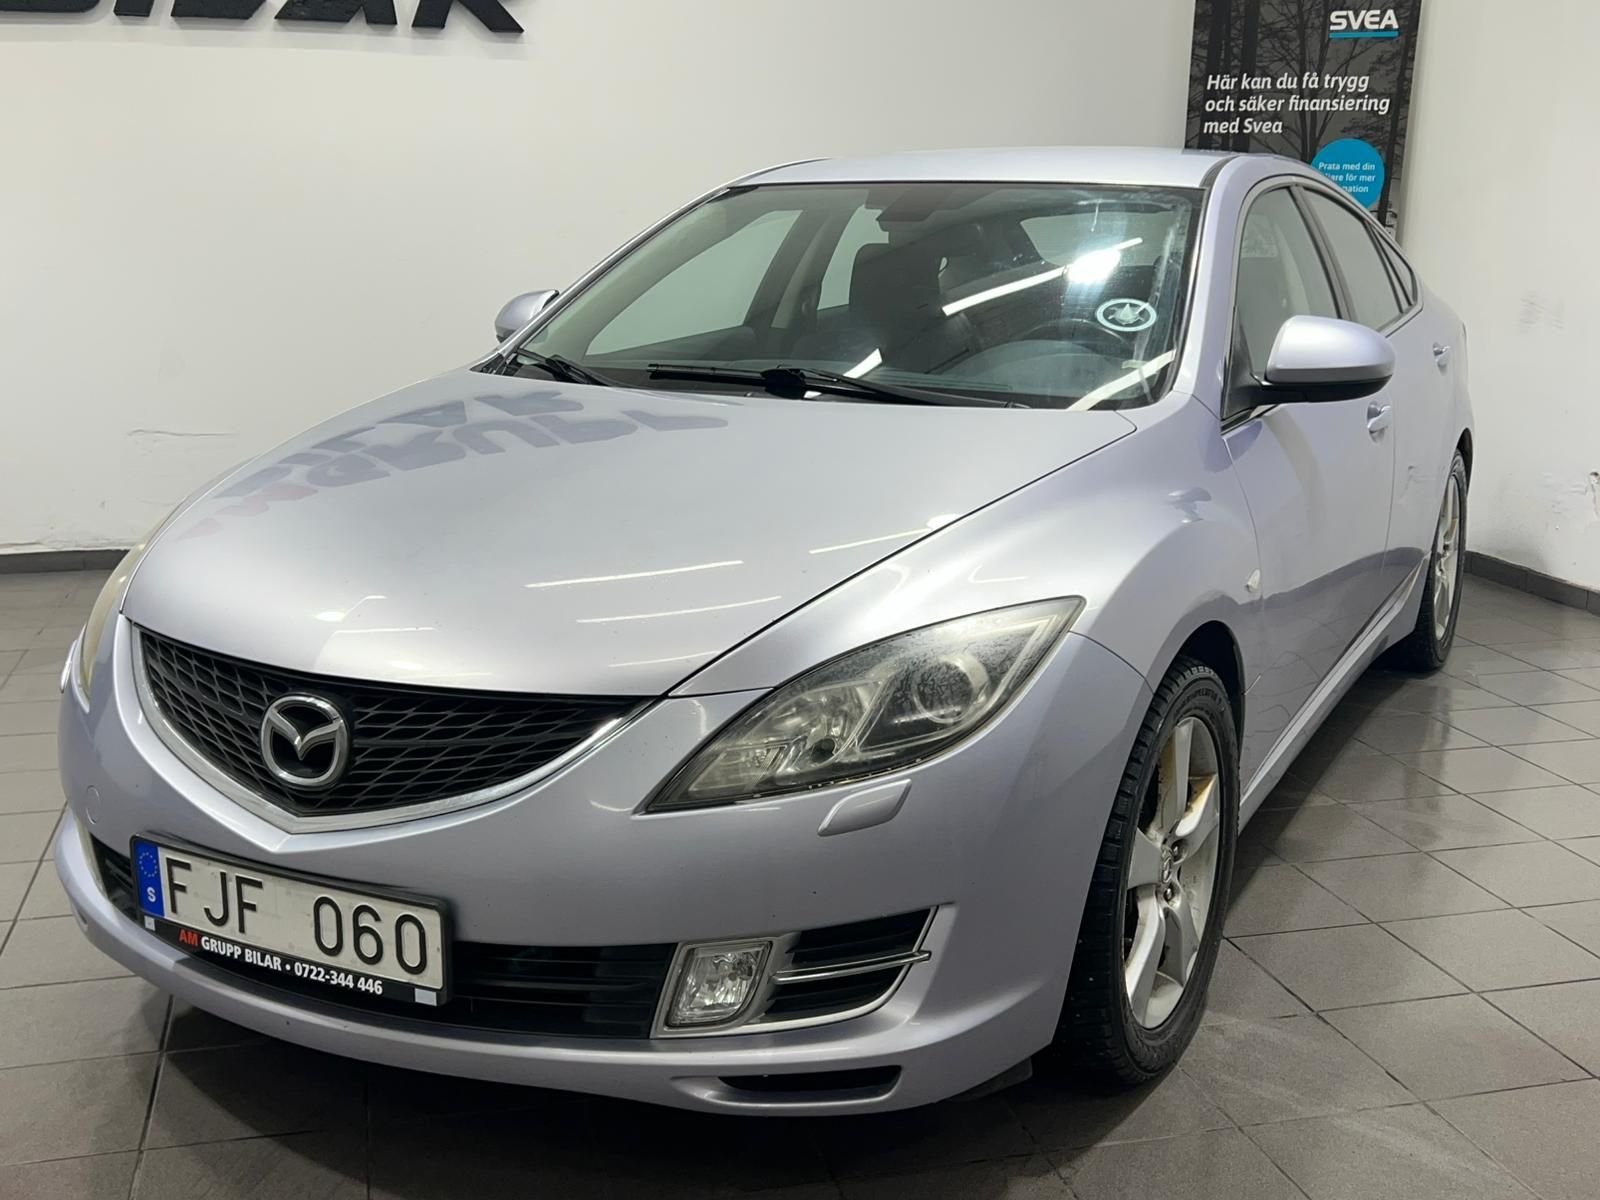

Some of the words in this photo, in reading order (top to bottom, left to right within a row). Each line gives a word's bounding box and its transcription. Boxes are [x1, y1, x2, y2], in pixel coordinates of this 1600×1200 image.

[1329, 9, 1399, 30] SVEA
[1206, 74, 1238, 90] Här
[1241, 72, 1271, 89] kan
[1276, 72, 1298, 89] du
[1302, 71, 1319, 89] få
[1324, 73, 1370, 92] trygg
[1205, 95, 1234, 112] och
[1238, 95, 1285, 112] säker
[1288, 94, 1390, 115] finansiering
[1203, 116, 1240, 134] med
[1243, 117, 1283, 134] Svea
[1318, 162, 1340, 170] Prata
[1342, 162, 1361, 170] med
[1362, 162, 1376, 170] din
[146, 886, 157, 903] S
[165, 856, 264, 934] FJF
[313, 896, 427, 975] 060
[178, 929, 199, 946] AM
[201, 935, 242, 960] GRUPP
[245, 948, 282, 971] BILAR
[294, 961, 354, 988] 0722-344
[357, 976, 383, 995] 446
